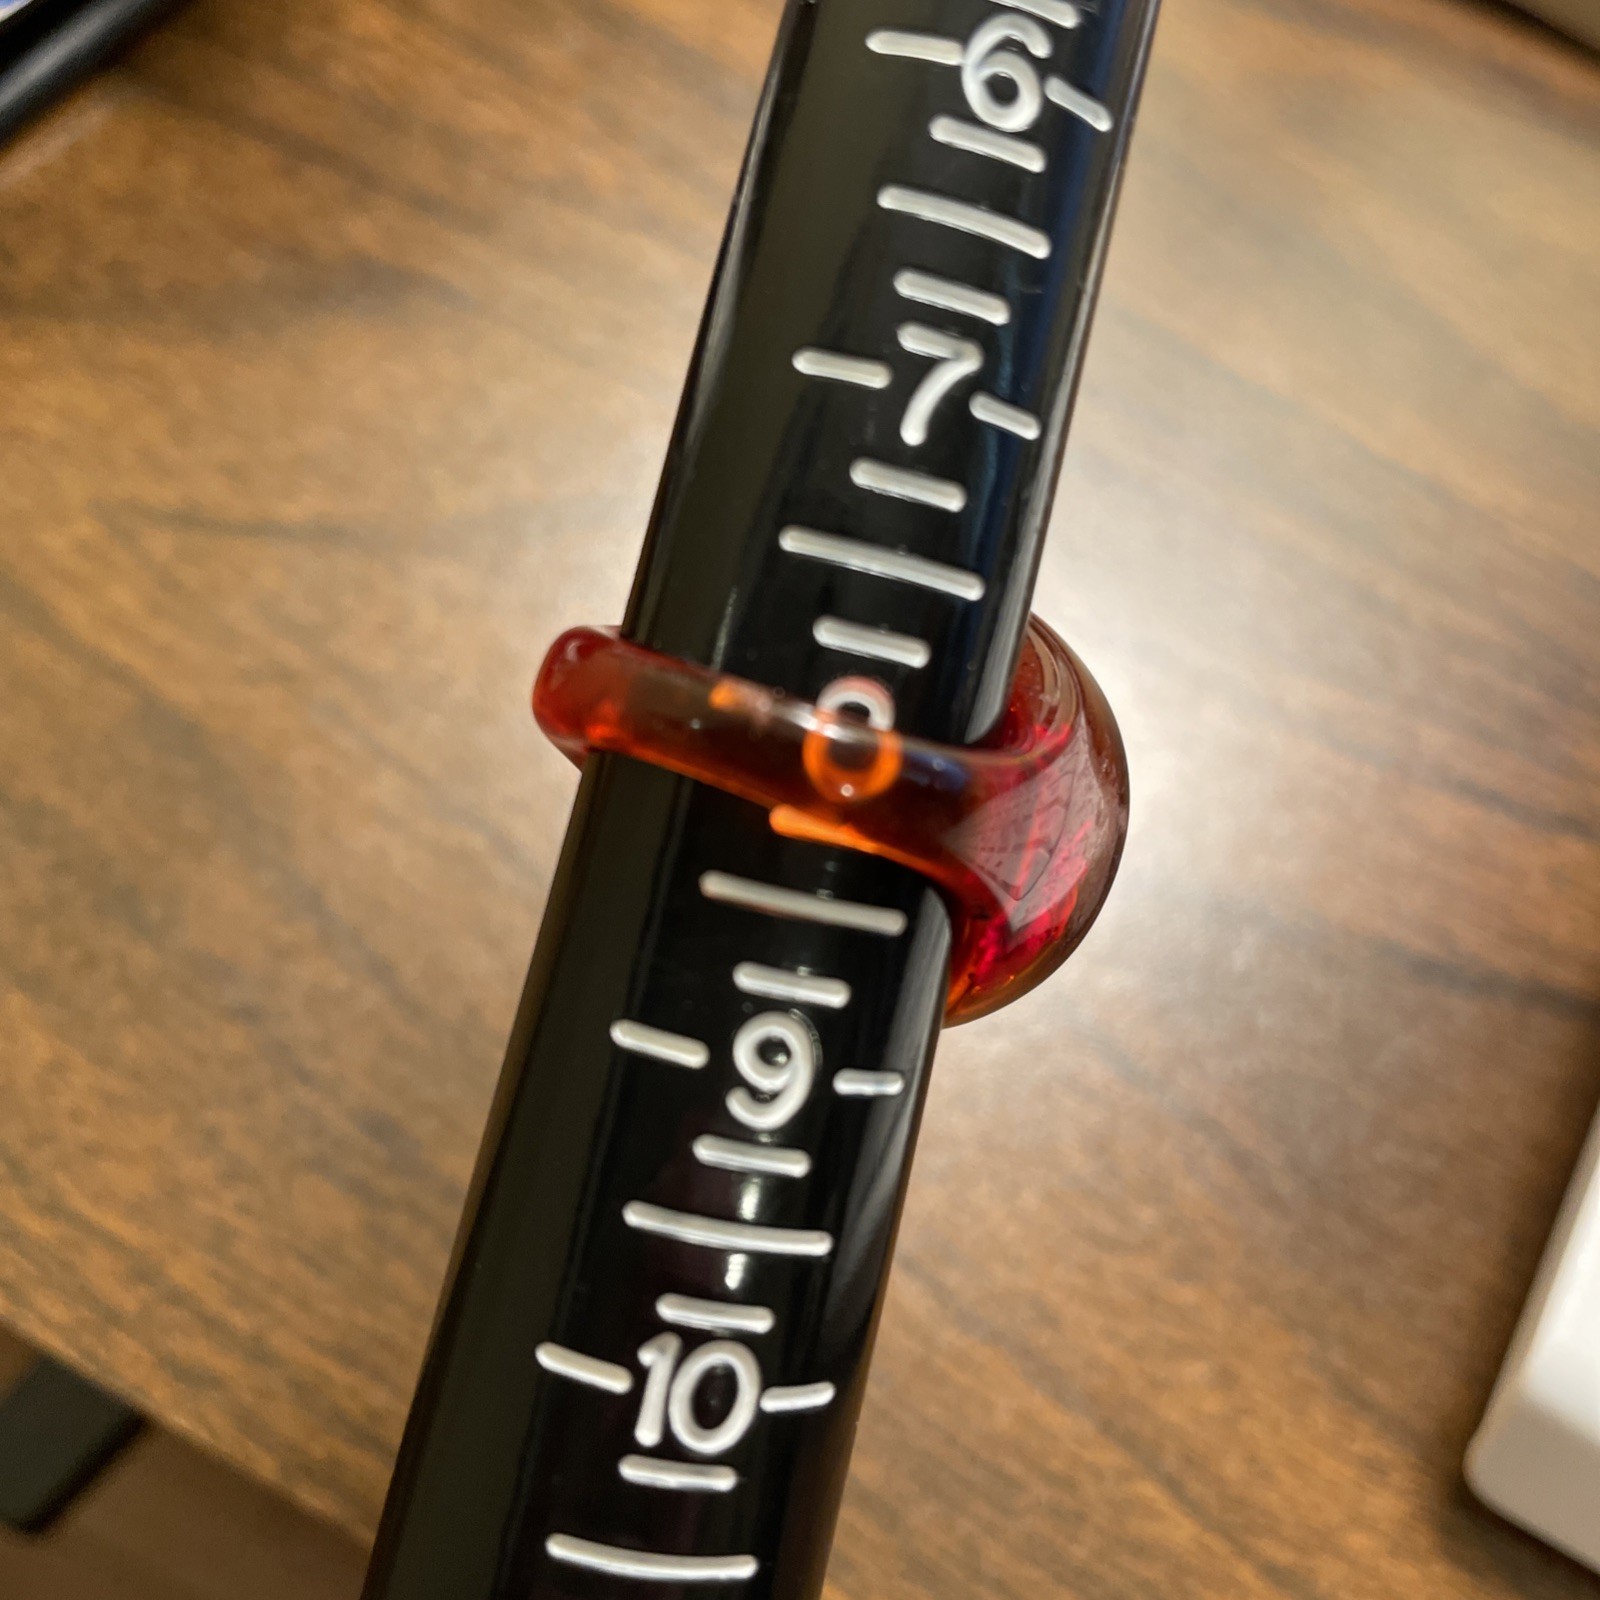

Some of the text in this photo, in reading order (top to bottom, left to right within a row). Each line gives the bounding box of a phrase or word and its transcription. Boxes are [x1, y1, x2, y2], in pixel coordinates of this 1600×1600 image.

[961, 12, 1053, 132] 6
[897, 321, 984, 446] 7
[725, 1010, 816, 1131] 9
[634, 1331, 762, 1454] 10
